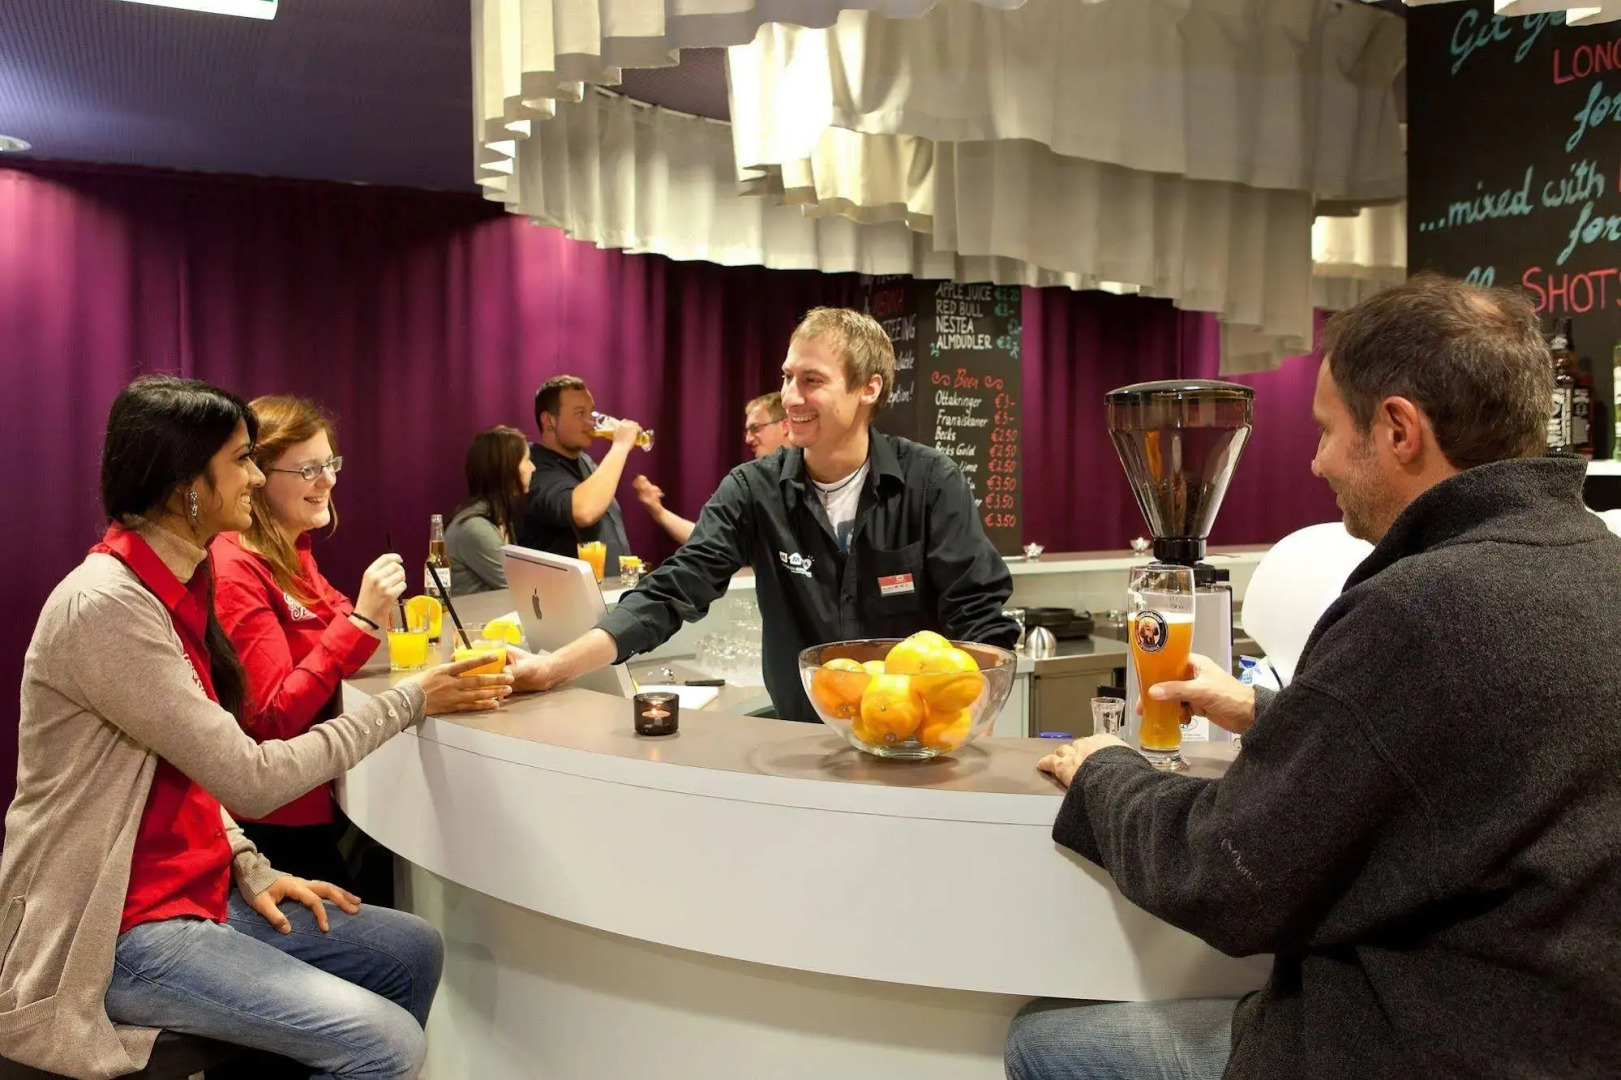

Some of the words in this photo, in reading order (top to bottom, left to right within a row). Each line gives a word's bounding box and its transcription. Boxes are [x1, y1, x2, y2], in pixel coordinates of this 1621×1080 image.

[1541, 158, 1605, 208] with
[1556, 200, 1621, 266] for
[935, 282, 964, 300] APPLE
[965, 285, 992, 301] JUICE
[935, 299, 957, 315] RED
[959, 301, 984, 317] BULL
[935, 316, 975, 334] NESTEA
[936, 334, 993, 350] ALMDUDLER
[935, 389, 982, 413] Ottakringer
[935, 426, 956, 441] Becks
[956, 443, 976, 456] Gold
